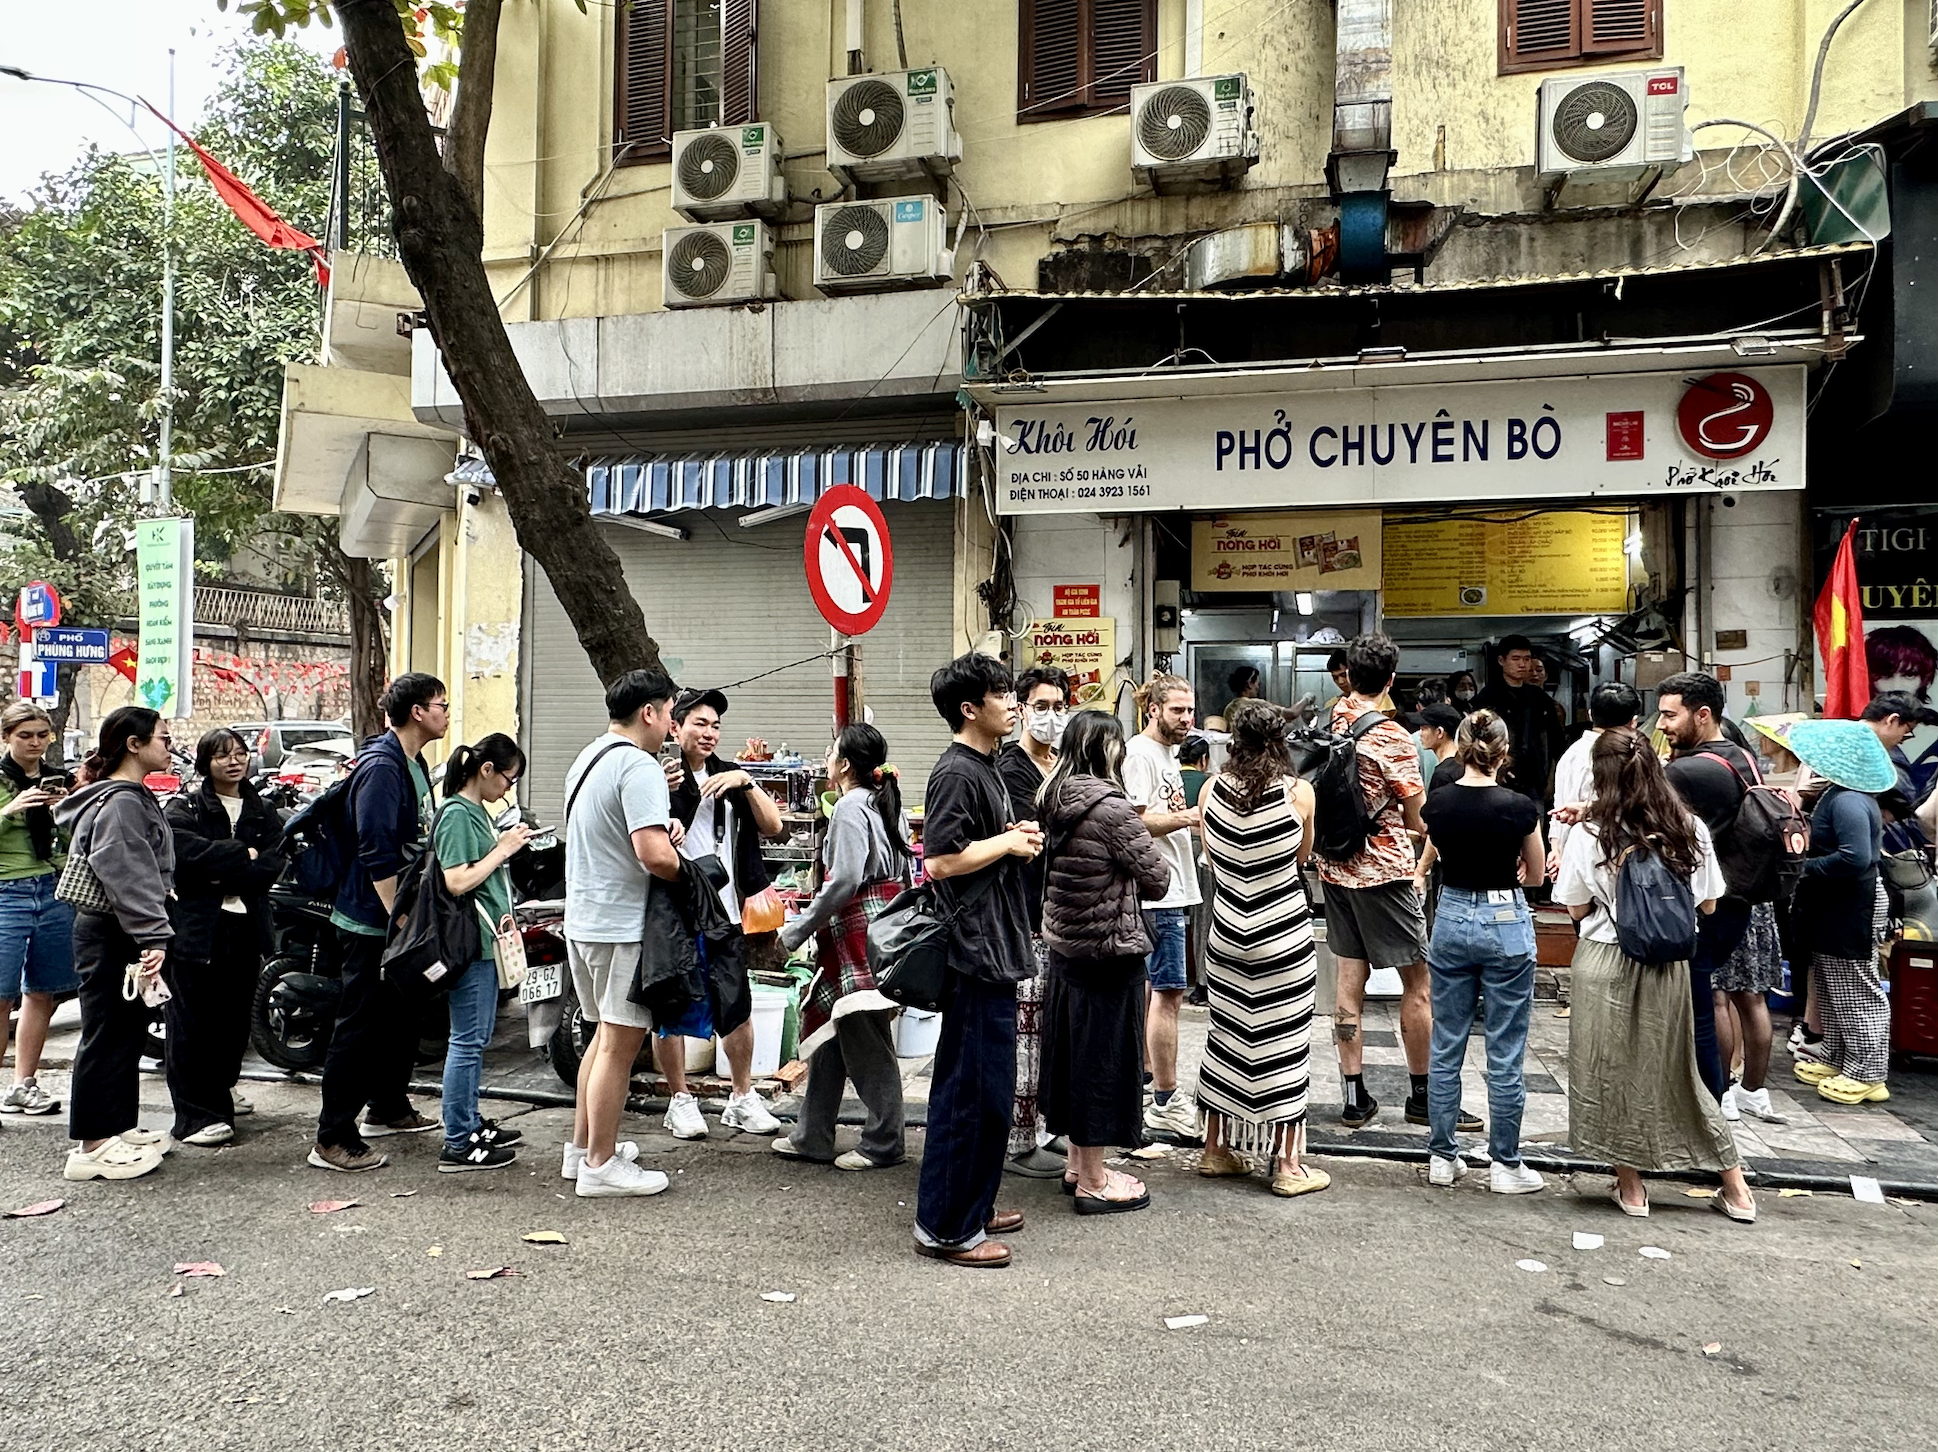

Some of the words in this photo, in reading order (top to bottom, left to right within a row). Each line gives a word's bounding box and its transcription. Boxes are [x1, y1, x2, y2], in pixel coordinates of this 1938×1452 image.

[1651, 82, 1674, 91] TCL
[1216, 409, 1292, 470] PHỞ
[1309, 409, 1488, 468] CHUYÊN
[1508, 404, 1562, 460] BÒ
[1060, 467, 1074, 482] SỐ
[1076, 470, 1089, 481] 50
[1092, 467, 1125, 480] HÀNG
[1128, 464, 1147, 479] VẢI
[1010, 488, 1036, 502] ĐIỆN
[1038, 488, 1069, 501] THOẠI
[1078, 486, 1096, 498] 024
[1099, 486, 1124, 497] 3923
[1128, 485, 1150, 496] 1561
[1858, 528, 1927, 552] TIGI
[58, 632, 84, 642] PHỐ
[38, 642, 73, 657] PHÙNG
[76, 644, 104, 658] HƯNG
[522, 981, 558, 1002] 066.17
